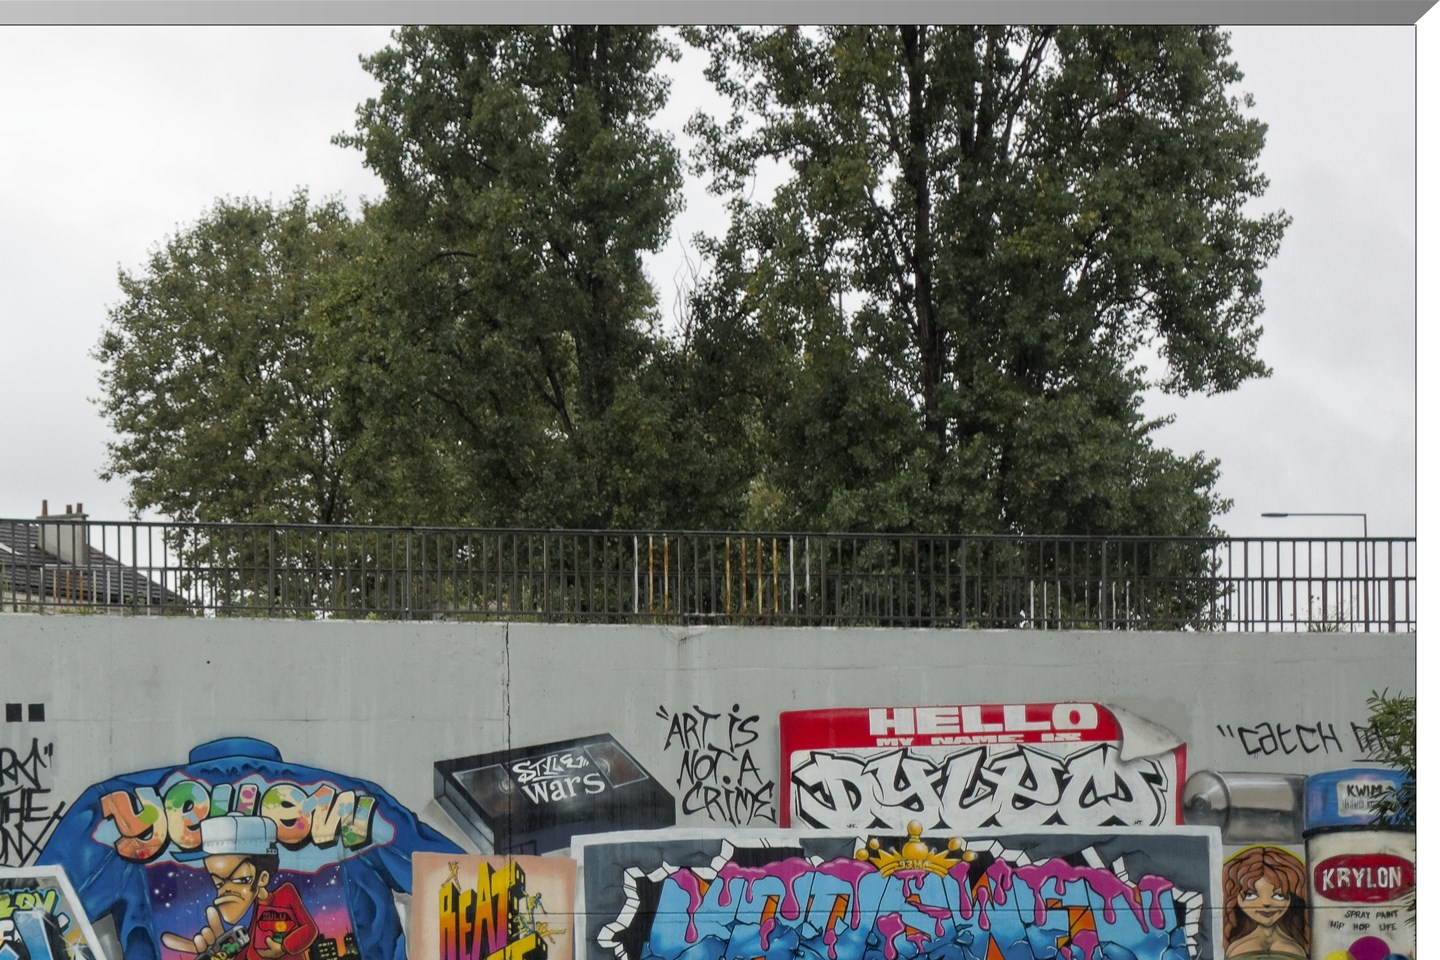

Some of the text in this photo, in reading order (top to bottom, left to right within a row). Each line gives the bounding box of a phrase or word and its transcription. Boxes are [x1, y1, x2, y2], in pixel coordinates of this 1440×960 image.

[869, 703, 1099, 736] HELLO
[876, 732, 1082, 747] MY NAME IS
[737, 749, 763, 787] A
[1322, 866, 1402, 892] KRYLON
[262, 911, 287, 921] ZULU
[1344, 909, 1399, 919] SPRAY PAINT
[1353, 923, 1371, 931] HOP
